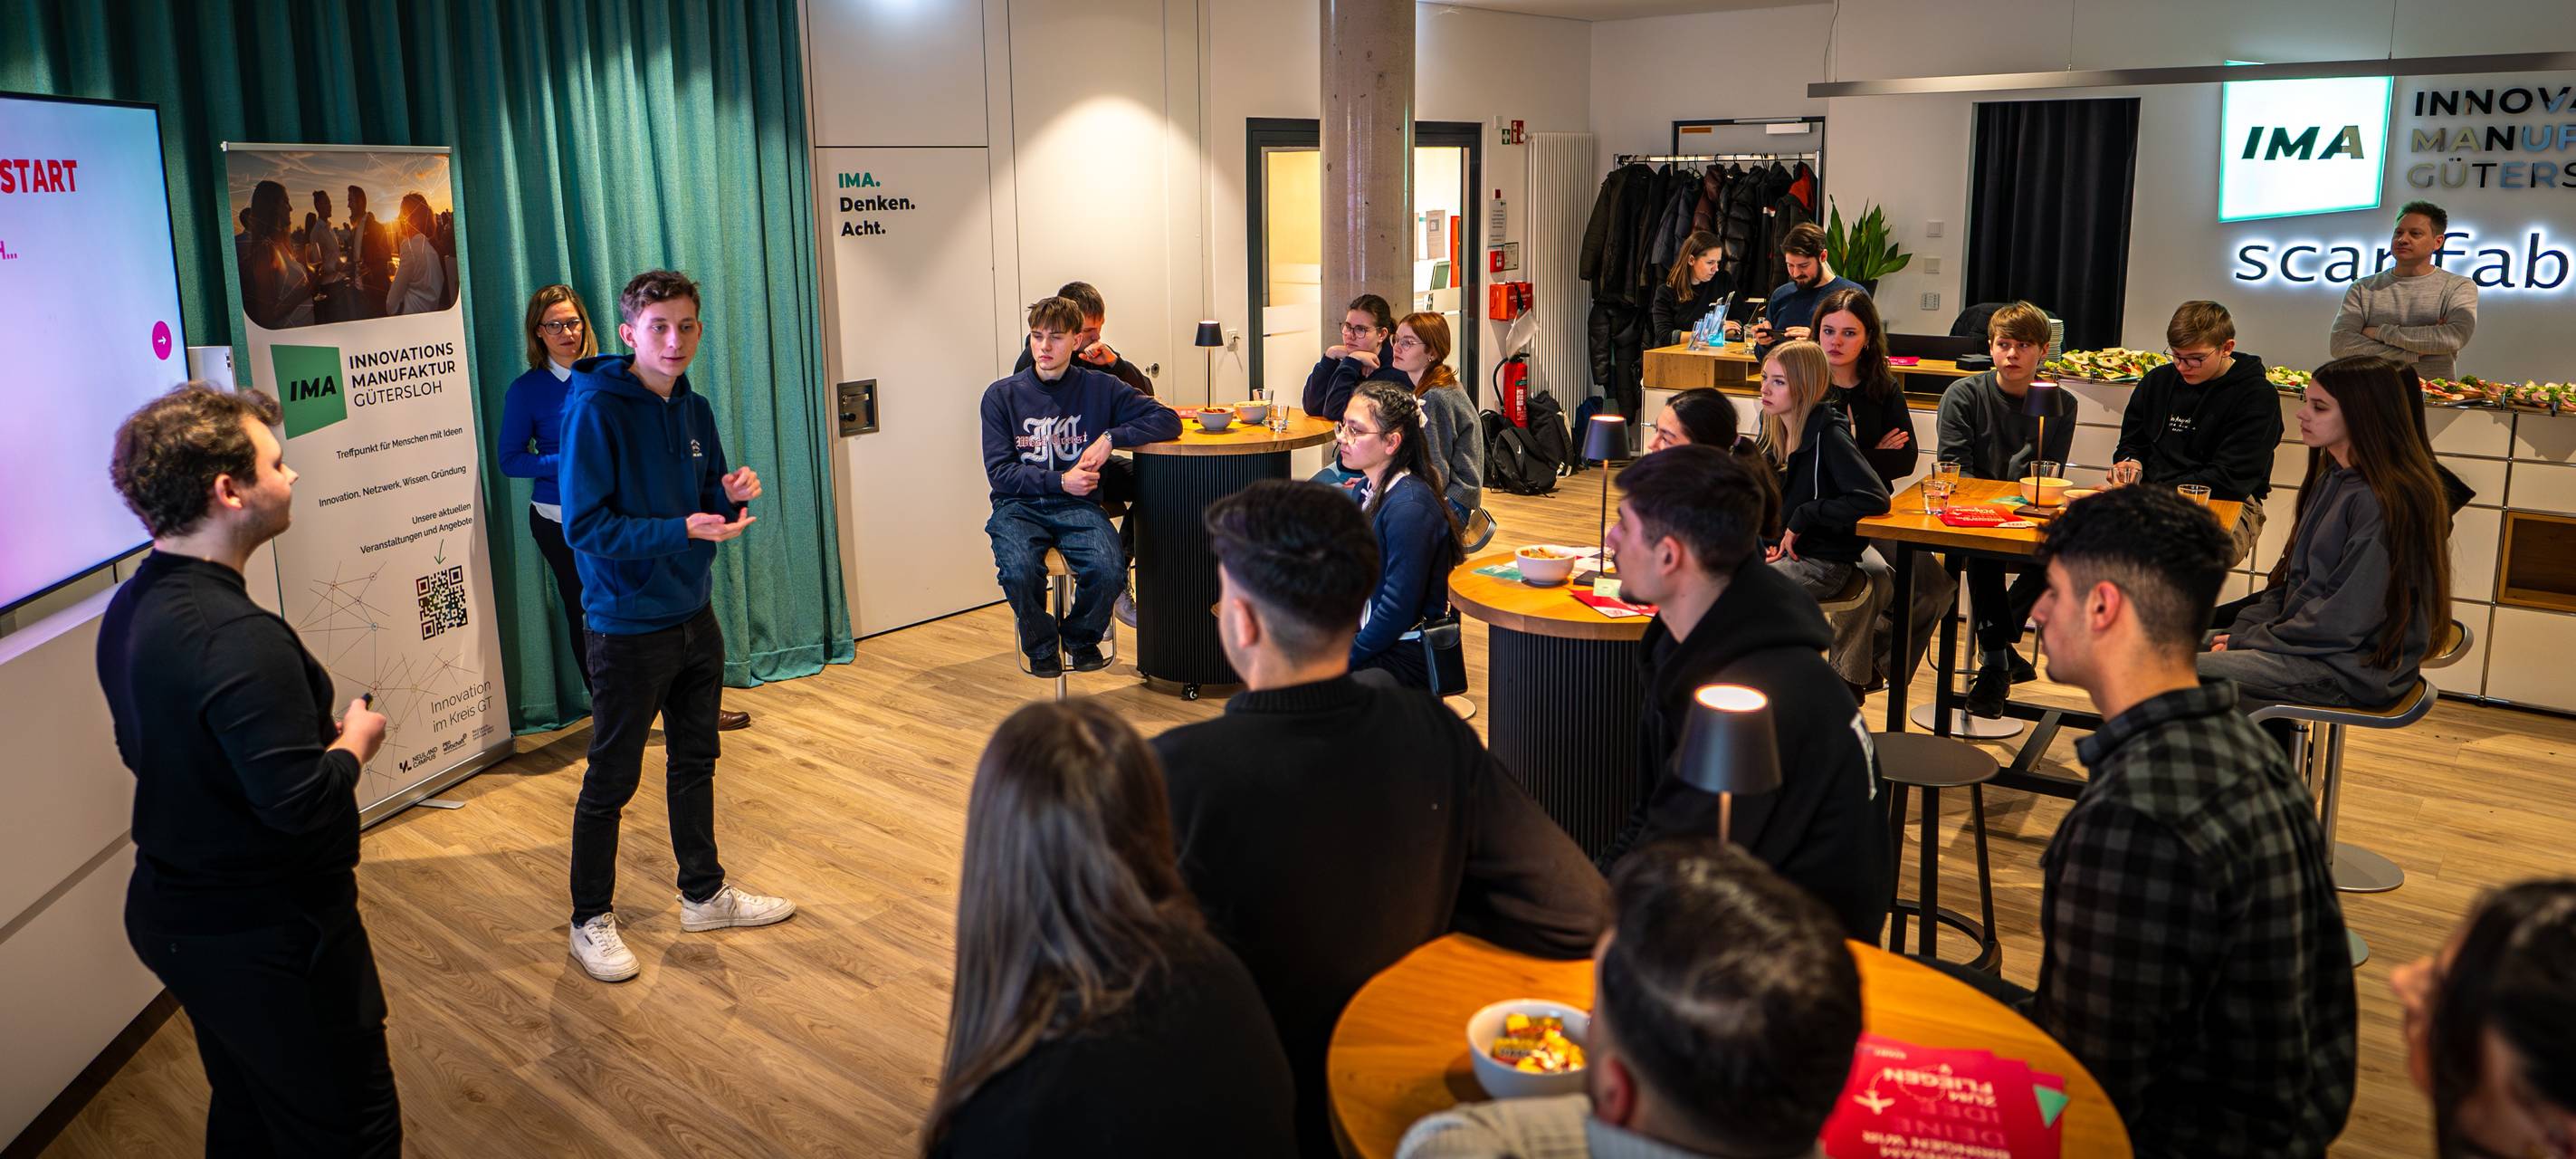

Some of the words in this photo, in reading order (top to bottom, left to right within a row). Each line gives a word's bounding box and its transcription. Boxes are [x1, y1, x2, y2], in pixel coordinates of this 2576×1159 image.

[2241, 124, 2364, 160] IMA
[2410, 124, 2576, 153] MANUF
[0, 158, 78, 194] START
[838, 172, 881, 188] IMA.
[839, 195, 916, 212] Denken.
[841, 220, 886, 236] Acht.
[349, 342, 454, 369] INNOVATIONS
[290, 375, 337, 402] IMA
[351, 360, 456, 388] MANUFAKTUR
[354, 380, 443, 407] GÜTERSLOH
[336, 443, 378, 460] Treffpunkt
[379, 442, 391, 452] für
[392, 434, 429, 448] Menschen
[430, 430, 443, 440] mit
[444, 426, 463, 437] Ideen
[319, 489, 361, 507] Innovation,
[362, 481, 402, 497] Netzwerk,
[403, 474, 430, 486] Wissen,
[431, 465, 467, 481] Gründung
[412, 511, 437, 524] Unsere
[438, 503, 472, 518] aktuellen
[360, 531, 423, 554] Veranstaltungen
[424, 524, 438, 537] und
[439, 516, 472, 532] Angebote
[431, 680, 491, 714] Innovation
[433, 719, 448, 733] im
[450, 707, 476, 725] Kreis
[477, 696, 493, 714] GT
[1882, 1067, 1994, 1096] FLIEGEN
